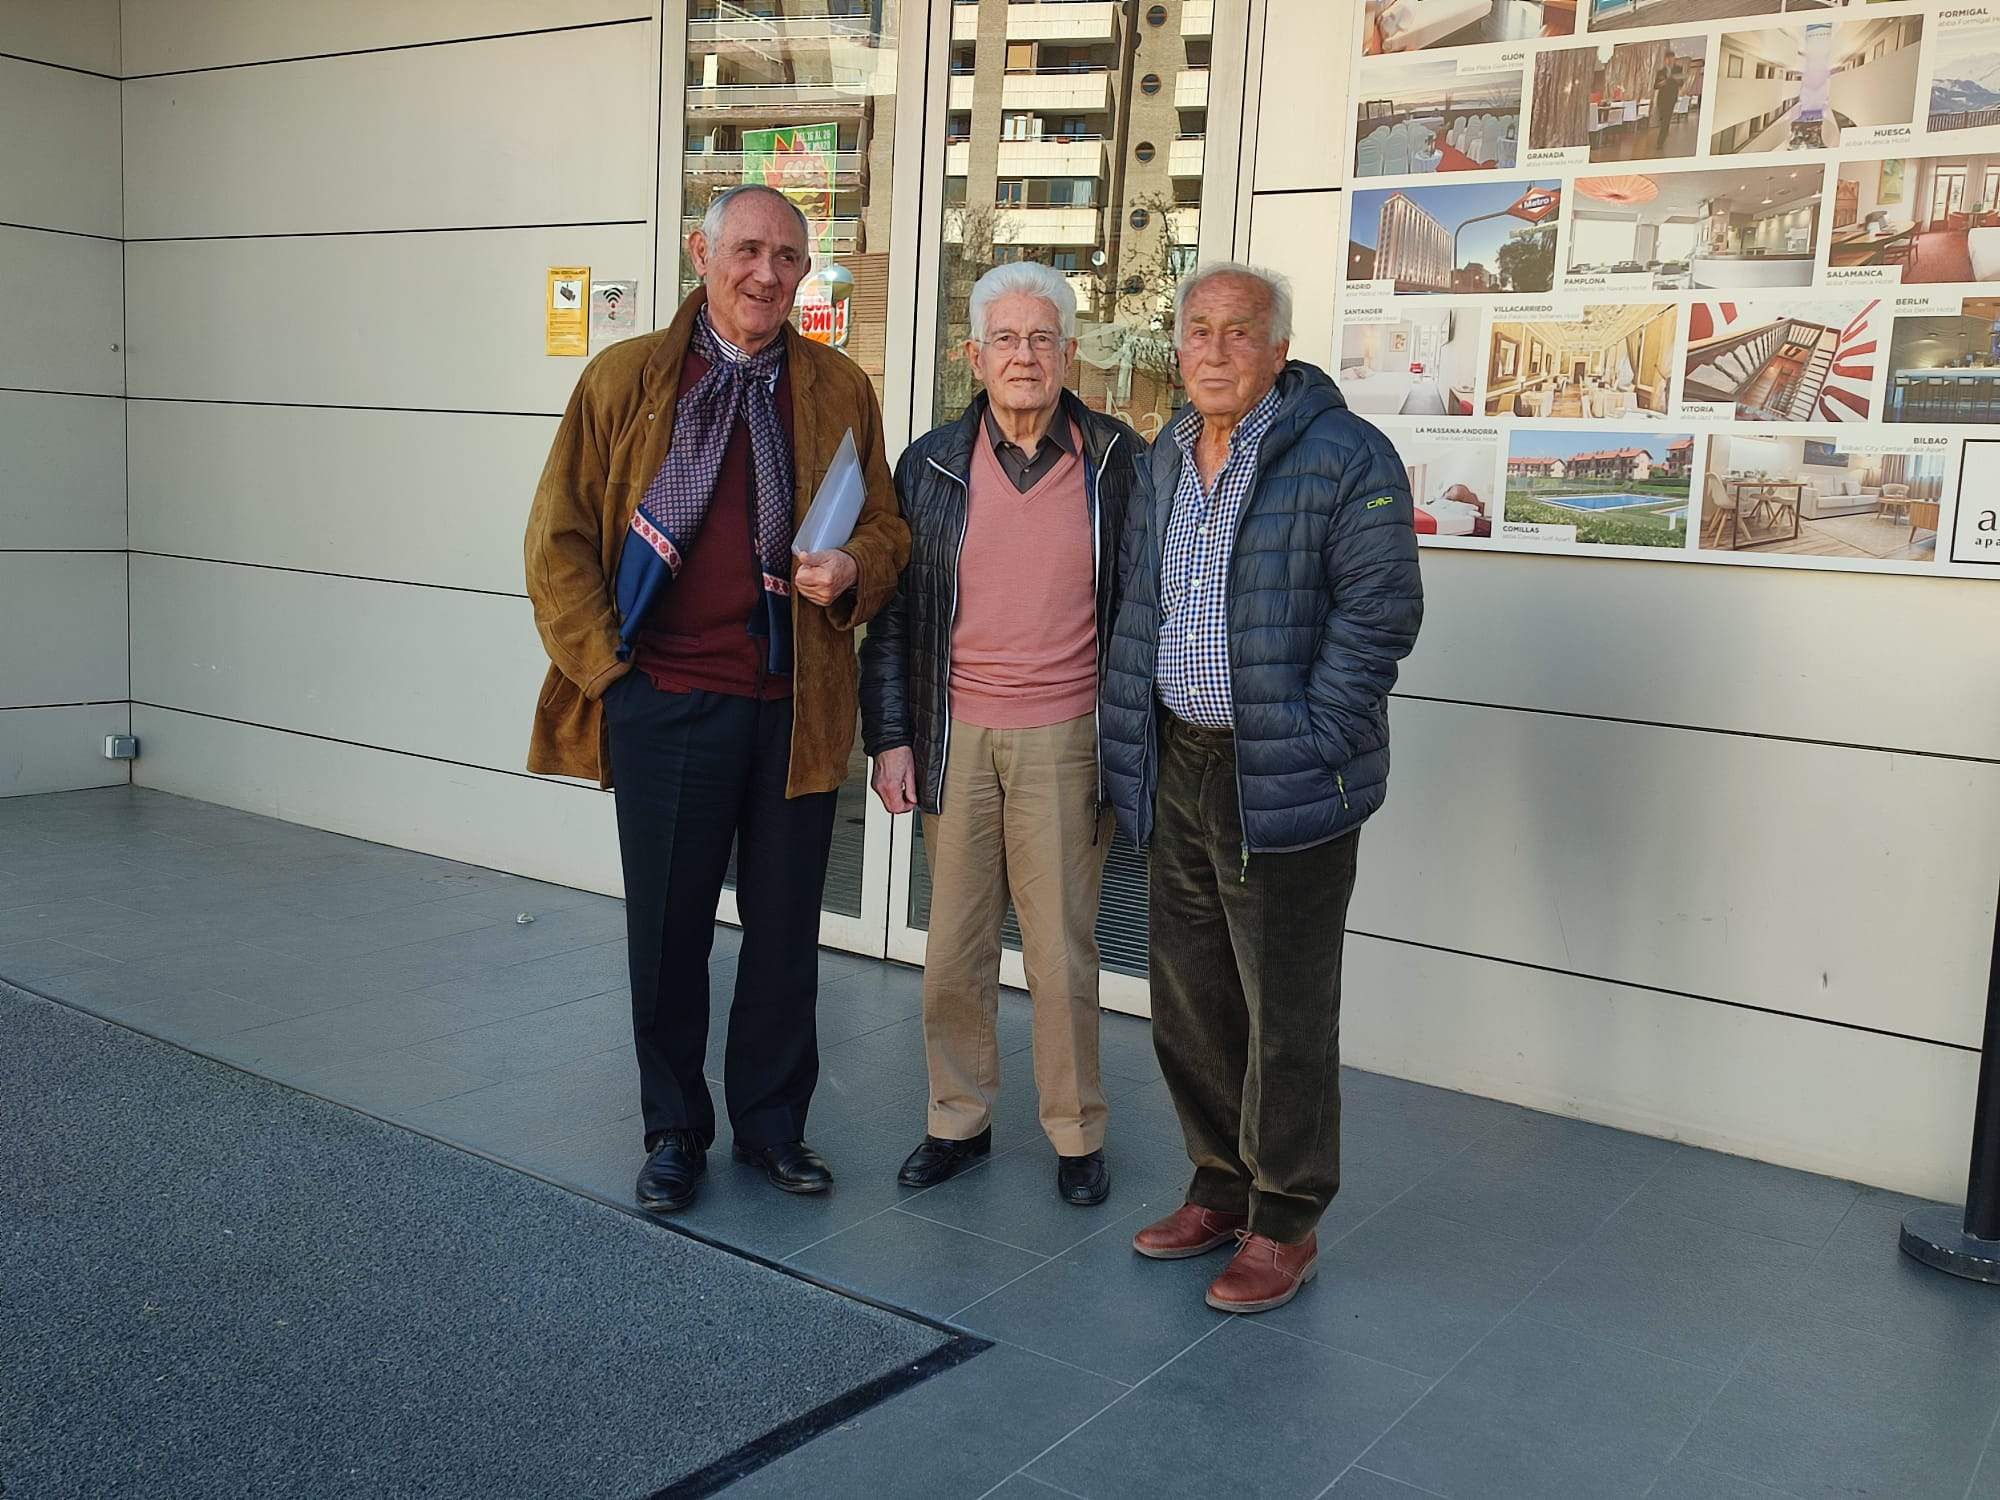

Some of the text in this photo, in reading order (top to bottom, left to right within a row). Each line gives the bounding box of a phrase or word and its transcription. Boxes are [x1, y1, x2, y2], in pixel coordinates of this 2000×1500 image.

[1938, 8, 1989, 18] FORMIGAL
[1874, 128, 1911, 137] HUESCA
[1527, 152, 1565, 160] GRANADA
[1523, 197, 1550, 208] Metro
[1826, 270, 1883, 278] SALAMANCA
[1895, 298, 1929, 306] BERLIN
[1494, 305, 1553, 313] VILLACARRIEDO
[1427, 427, 1498, 435] MASSANA-ANDORRA
[1913, 437, 1948, 445] BILBAO
[1503, 525, 1540, 533] COMILLAS
